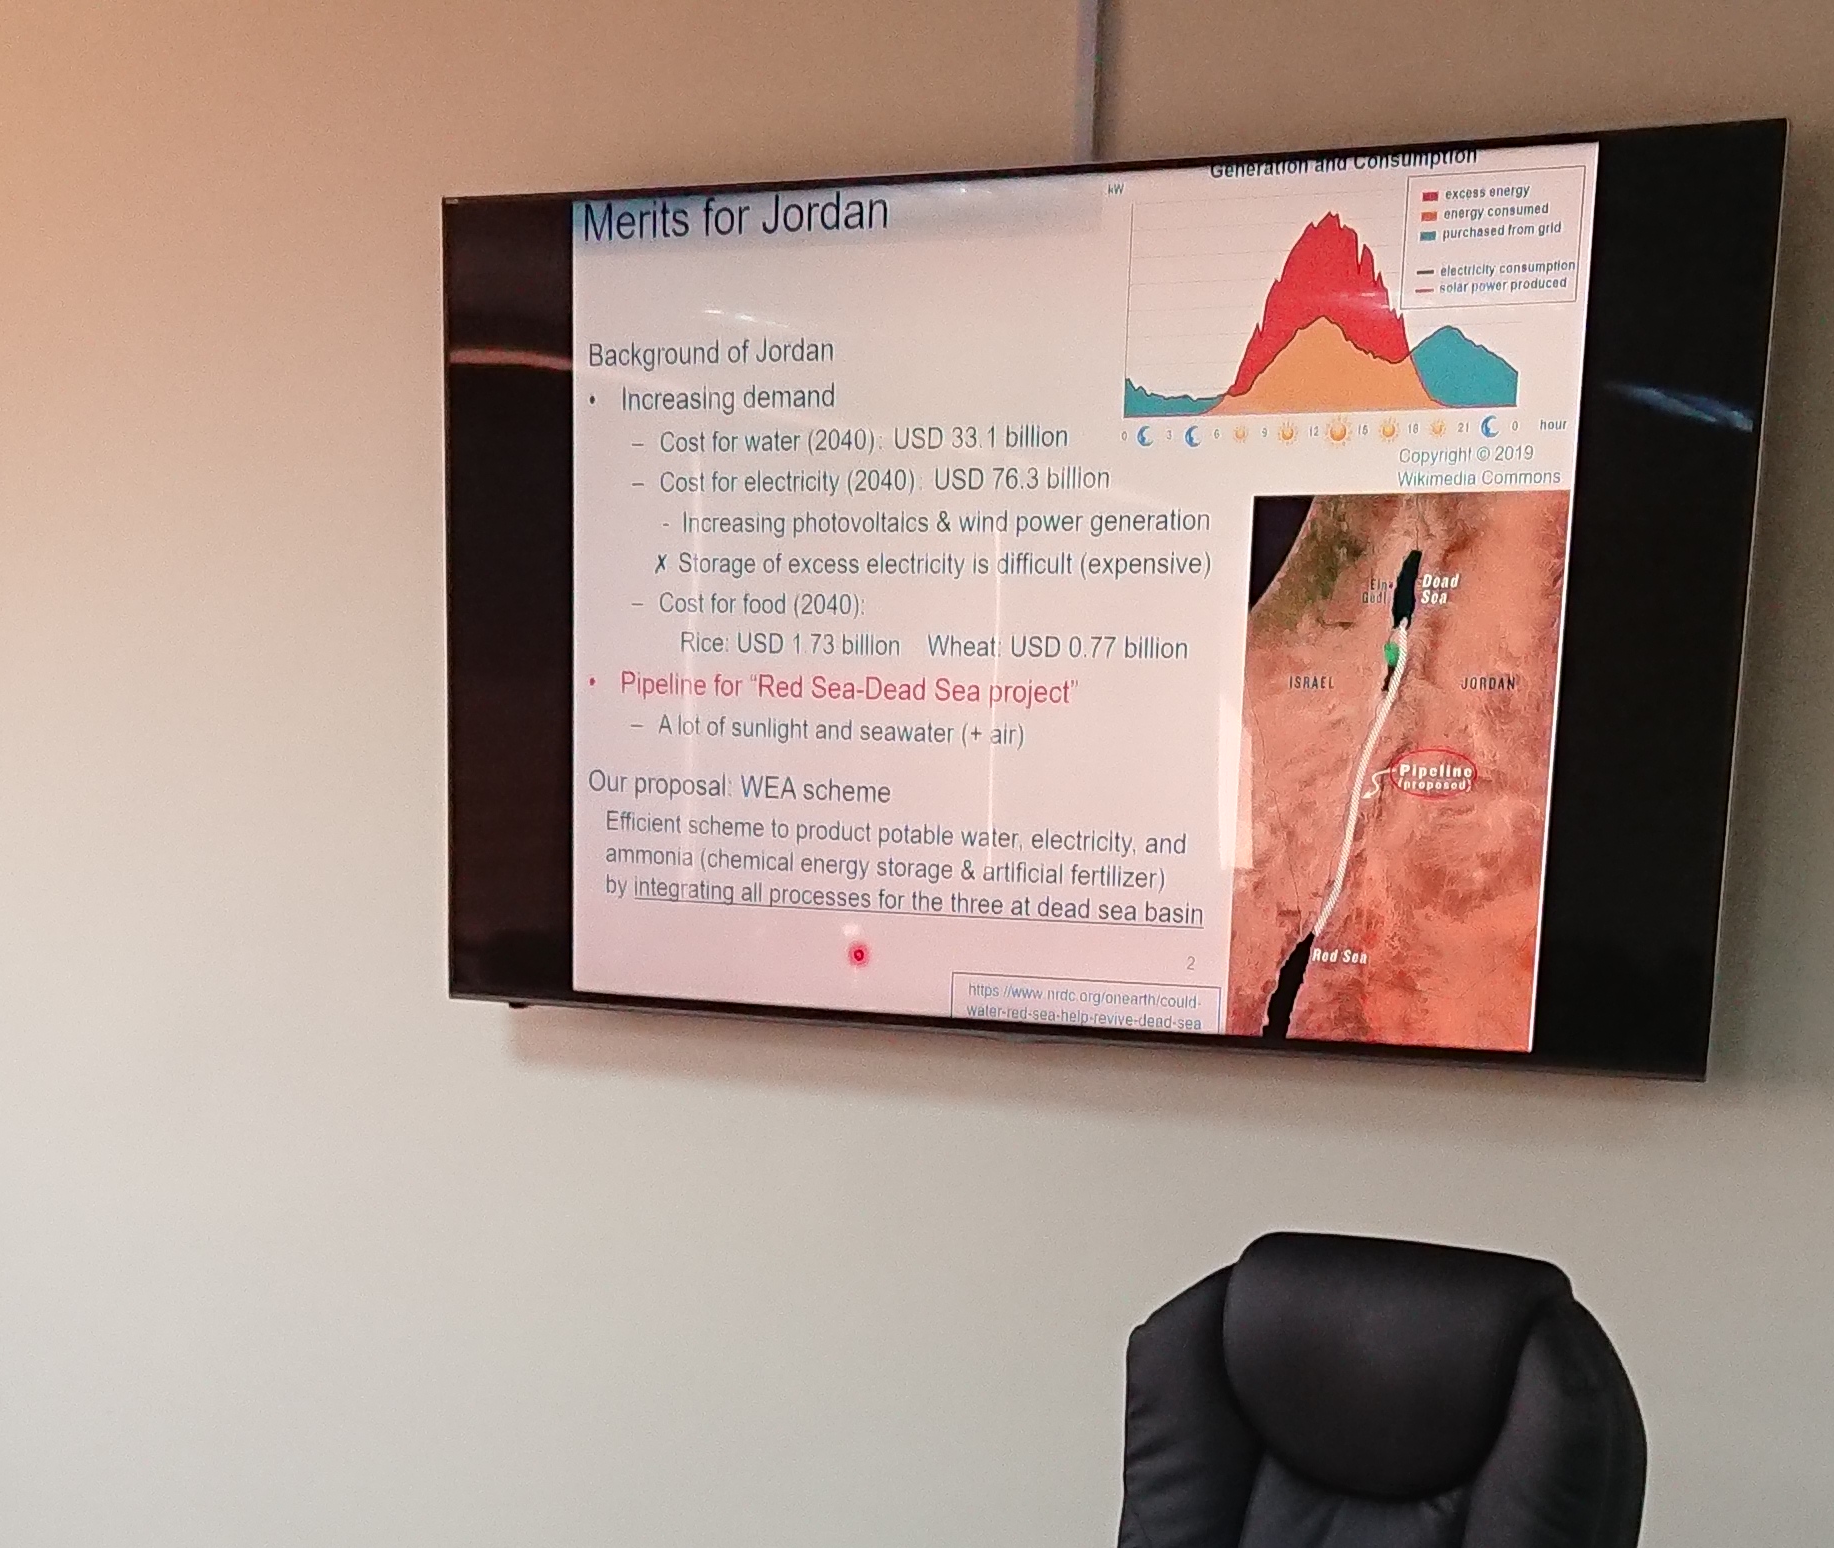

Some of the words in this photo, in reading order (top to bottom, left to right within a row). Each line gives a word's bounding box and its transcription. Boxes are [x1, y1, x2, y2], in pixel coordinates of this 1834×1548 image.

[1210, 158, 1309, 179] Generation
[1314, 155, 1347, 173] and
[1353, 149, 1477, 169] Consumption
[1445, 187, 1486, 200] excess
[1489, 185, 1531, 199] energy
[583, 199, 690, 242] Merits
[704, 197, 751, 238] for
[762, 191, 890, 235] Jordan
[1443, 207, 1485, 221] energy
[1487, 203, 1549, 217] consumed
[1442, 225, 1505, 242] purchased
[1507, 223, 1535, 236] from
[1538, 221, 1562, 237] grid
[1440, 263, 1496, 278] electricity
[1499, 260, 1576, 275] consumption
[1439, 281, 1467, 294] solar
[1471, 281, 1507, 295] power
[1510, 277, 1567, 293] produced
[589, 340, 720, 371] Background
[728, 339, 750, 364] of
[756, 338, 834, 363] Jordan
[622, 386, 735, 415] Increasing
[743, 382, 835, 409] demand
[660, 430, 705, 453] Cost
[712, 430, 738, 452] for
[745, 432, 800, 452] water
[893, 427, 943, 450] USD
[951, 427, 996, 449] 33.1
[1006, 425, 1068, 448] billion
[1308, 426, 1320, 438] 12
[1457, 422, 1470, 433] 21
[1540, 418, 1567, 432] hour
[1399, 448, 1473, 466] Copyright
[1494, 445, 1534, 462] 2019
[660, 471, 705, 494] Cost
[712, 470, 738, 493] for
[744, 470, 840, 496] electricity
[934, 468, 984, 490] USD
[992, 468, 1039, 490] 76.3
[1047, 467, 1110, 489] billion
[1398, 470, 1476, 487] Wikimedia
[1481, 468, 1561, 486] Commons
[682, 511, 785, 538] Increasing
[793, 512, 929, 538] photovoltaics
[936, 510, 952, 533] &
[959, 510, 1008, 533] wind
[1016, 513, 1084, 537] power
[1090, 509, 1210, 538] generation
[678, 552, 756, 579] Storage
[763, 552, 782, 574] of
[788, 556, 860, 575] excess
[866, 552, 966, 579] electricity
[973, 553, 989, 574] is
[997, 551, 1073, 575] difficult
[1080, 551, 1212, 580] (expensive)
[659, 592, 705, 614] Cost
[711, 592, 736, 614] for
[743, 593, 786, 614] food
[793, 592, 865, 619] (2040):
[681, 631, 729, 653] Rice:
[737, 633, 784, 655] USD
[791, 634, 835, 656] 1.73
[842, 634, 901, 657] billion
[928, 634, 1002, 658] Wheat:
[1011, 636, 1061, 659] USD
[1068, 636, 1117, 660] 0.77
[1124, 636, 1189, 660] billion
[621, 670, 706, 699] Pipeline
[714, 673, 743, 697] for
[811, 675, 926, 702] Sea-Dead
[934, 677, 981, 702] Sea
[1289, 675, 1334, 690] ISRAEL
[1460, 676, 1516, 691] JORDAN
[658, 715, 673, 735] A
[678, 715, 701, 737] lot
[706, 716, 727, 737] of
[731, 718, 808, 744] sunlight
[815, 720, 853, 741] and
[860, 722, 955, 744] seawater
[961, 722, 983, 748] (+
[990, 723, 1025, 750] air)
[1399, 763, 1473, 779] Pipeline
[589, 769, 627, 793] Our
[634, 773, 733, 800] proposal:
[740, 775, 797, 800] WEA
[802, 778, 892, 803] scheme
[606, 810, 682, 834] Efficient
[688, 815, 765, 837] scheme
[771, 818, 789, 839] to
[796, 820, 871, 845] product
[878, 823, 954, 848] potable
[961, 827, 1023, 852] water,
[1031, 828, 1137, 857] electricity,
[1145, 833, 1187, 855] and
[605, 847, 693, 867] ammonia
[700, 847, 794, 872] (chemical
[800, 856, 870, 880] energy
[876, 858, 953, 883] storage
[961, 860, 976, 881] &
[982, 861, 1063, 885] artificial
[1071, 864, 1167, 893] fertilizer)
[606, 874, 627, 899] by
[634, 875, 734, 905] integrating
[741, 881, 763, 903] all
[770, 886, 872, 908] processes
[878, 888, 905, 910] for
[911, 889, 944, 912] the
[950, 892, 1004, 915] three
[1010, 896, 1031, 916] at
[1037, 896, 1091, 920] dead
[1098, 904, 1137, 923] sea
[1145, 899, 1204, 926] basin
[1185, 954, 1197, 971] 2
[968, 983, 1202, 1009] https//wwwnrdc.org/onearth/could-
